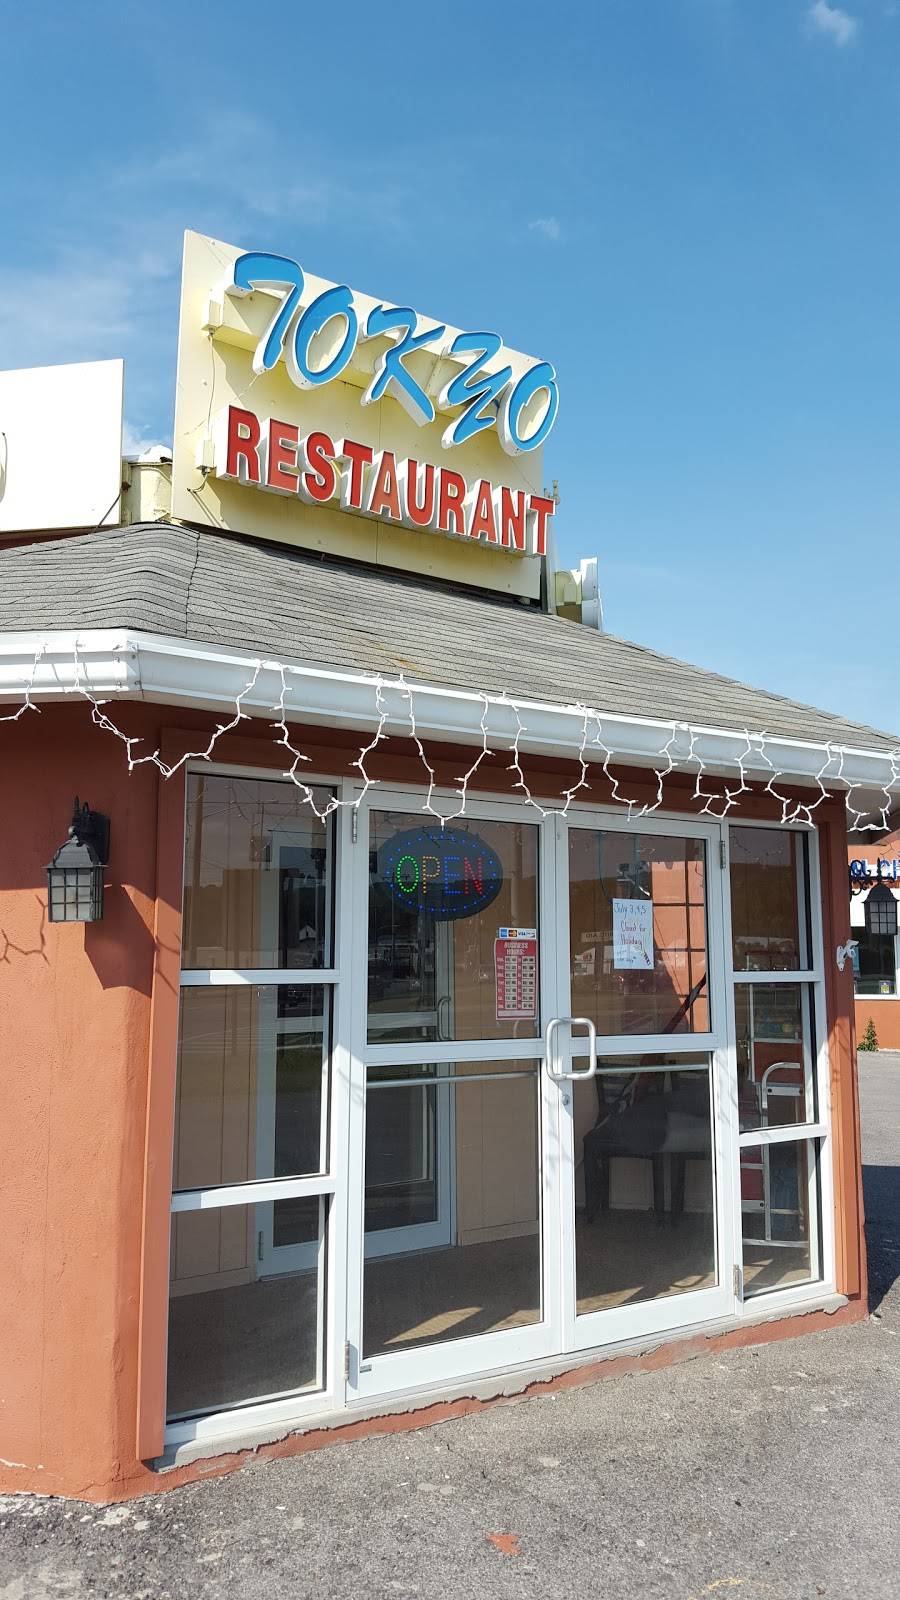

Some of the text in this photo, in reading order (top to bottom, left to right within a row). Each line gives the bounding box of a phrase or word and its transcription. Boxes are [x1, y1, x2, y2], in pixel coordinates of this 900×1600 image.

[233, 251, 560, 453] TOKYO
[226, 404, 556, 557] RESTAURANT
[395, 854, 484, 895] OPEN
